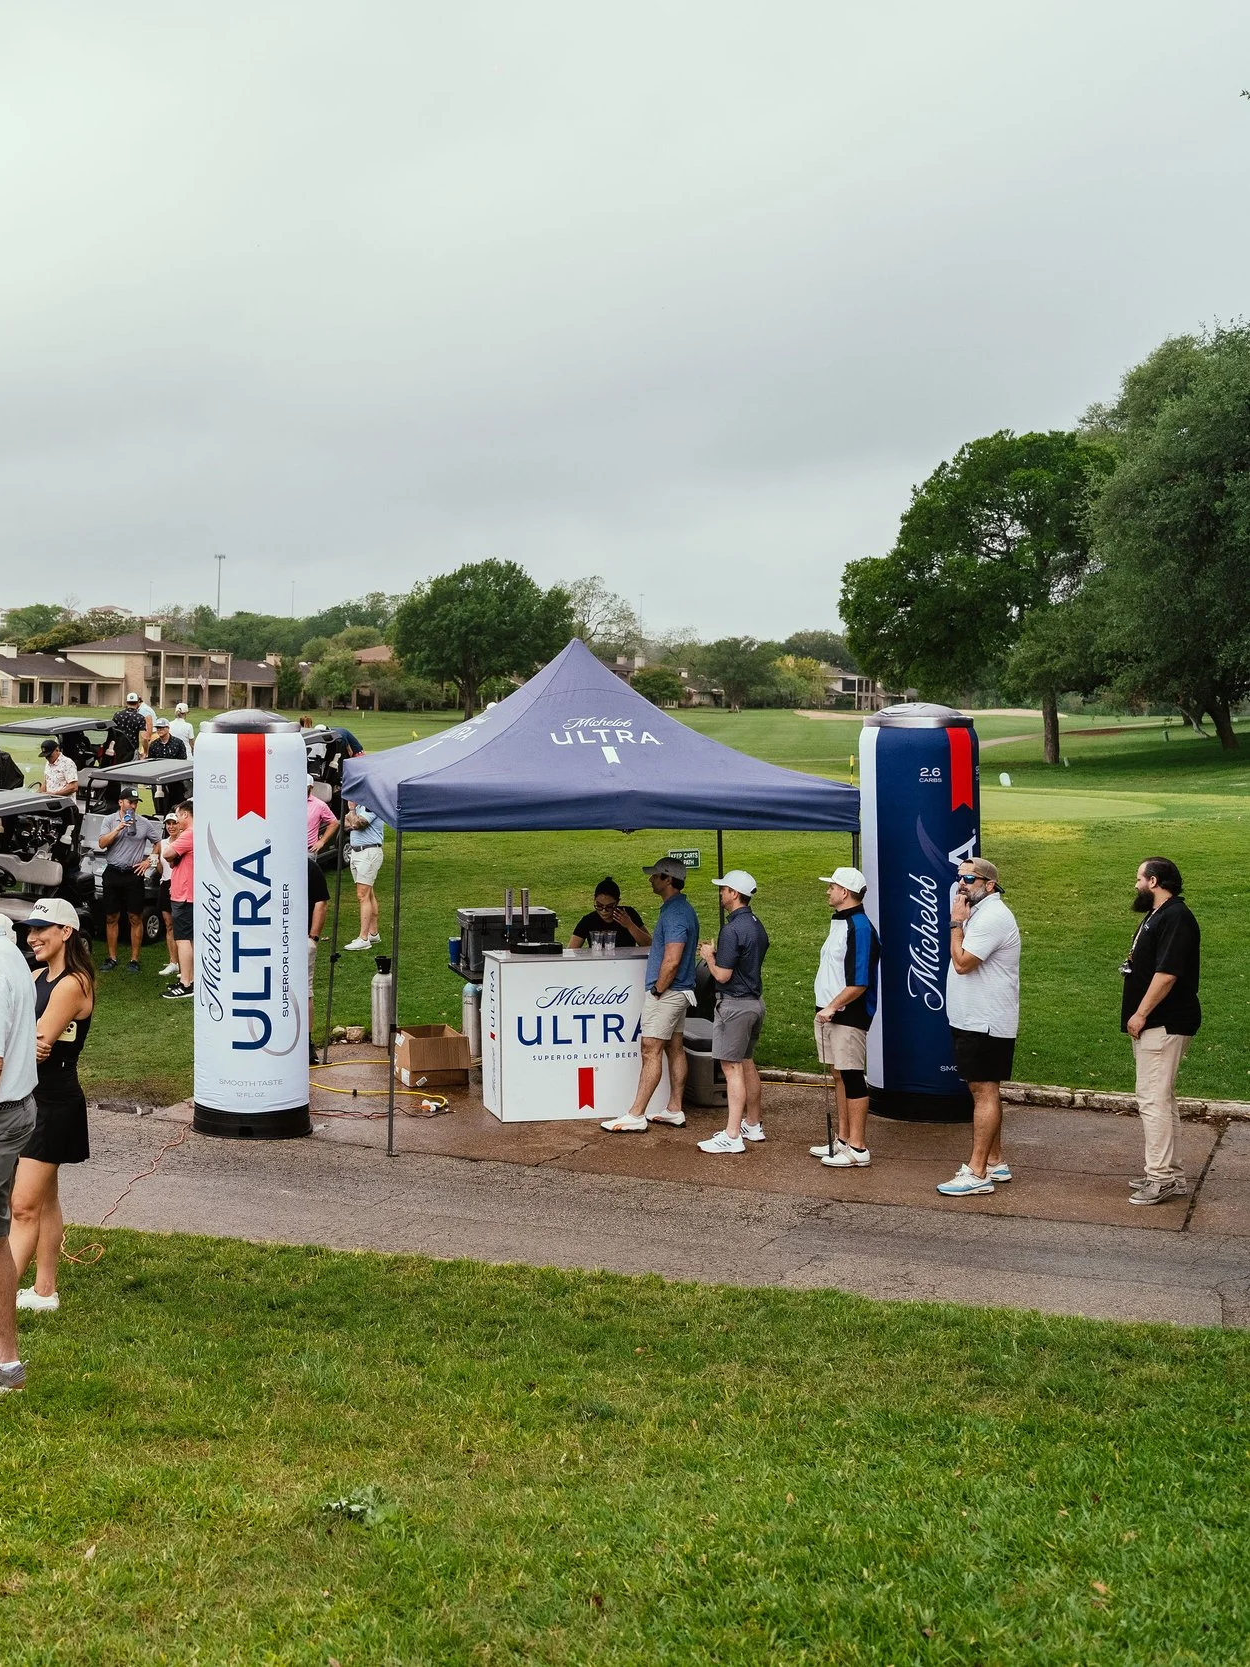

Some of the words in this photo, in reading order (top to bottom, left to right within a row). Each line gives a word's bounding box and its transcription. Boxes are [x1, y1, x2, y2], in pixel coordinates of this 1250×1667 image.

[562, 716, 633, 730] Michelob
[550, 729, 661, 745] ULTRA
[210, 774, 227, 783] 2.6
[274, 774, 290, 783] 95
[919, 767, 941, 777] 2.6
[282, 883, 290, 915] BEER
[282, 918, 290, 954] LIGHT
[907, 873, 944, 1011] Michelob
[200, 881, 224, 1022] Michelob
[232, 845, 272, 1050] ULTRA
[282, 957, 290, 1018] SUPERIOR
[535, 984, 633, 1009] Michelob
[532, 1053, 579, 1061] SUPERIOR
[583, 1052, 611, 1060] LIGHT
[615, 1051, 638, 1059] BEER
[219, 1079, 256, 1087] SMOOTH
